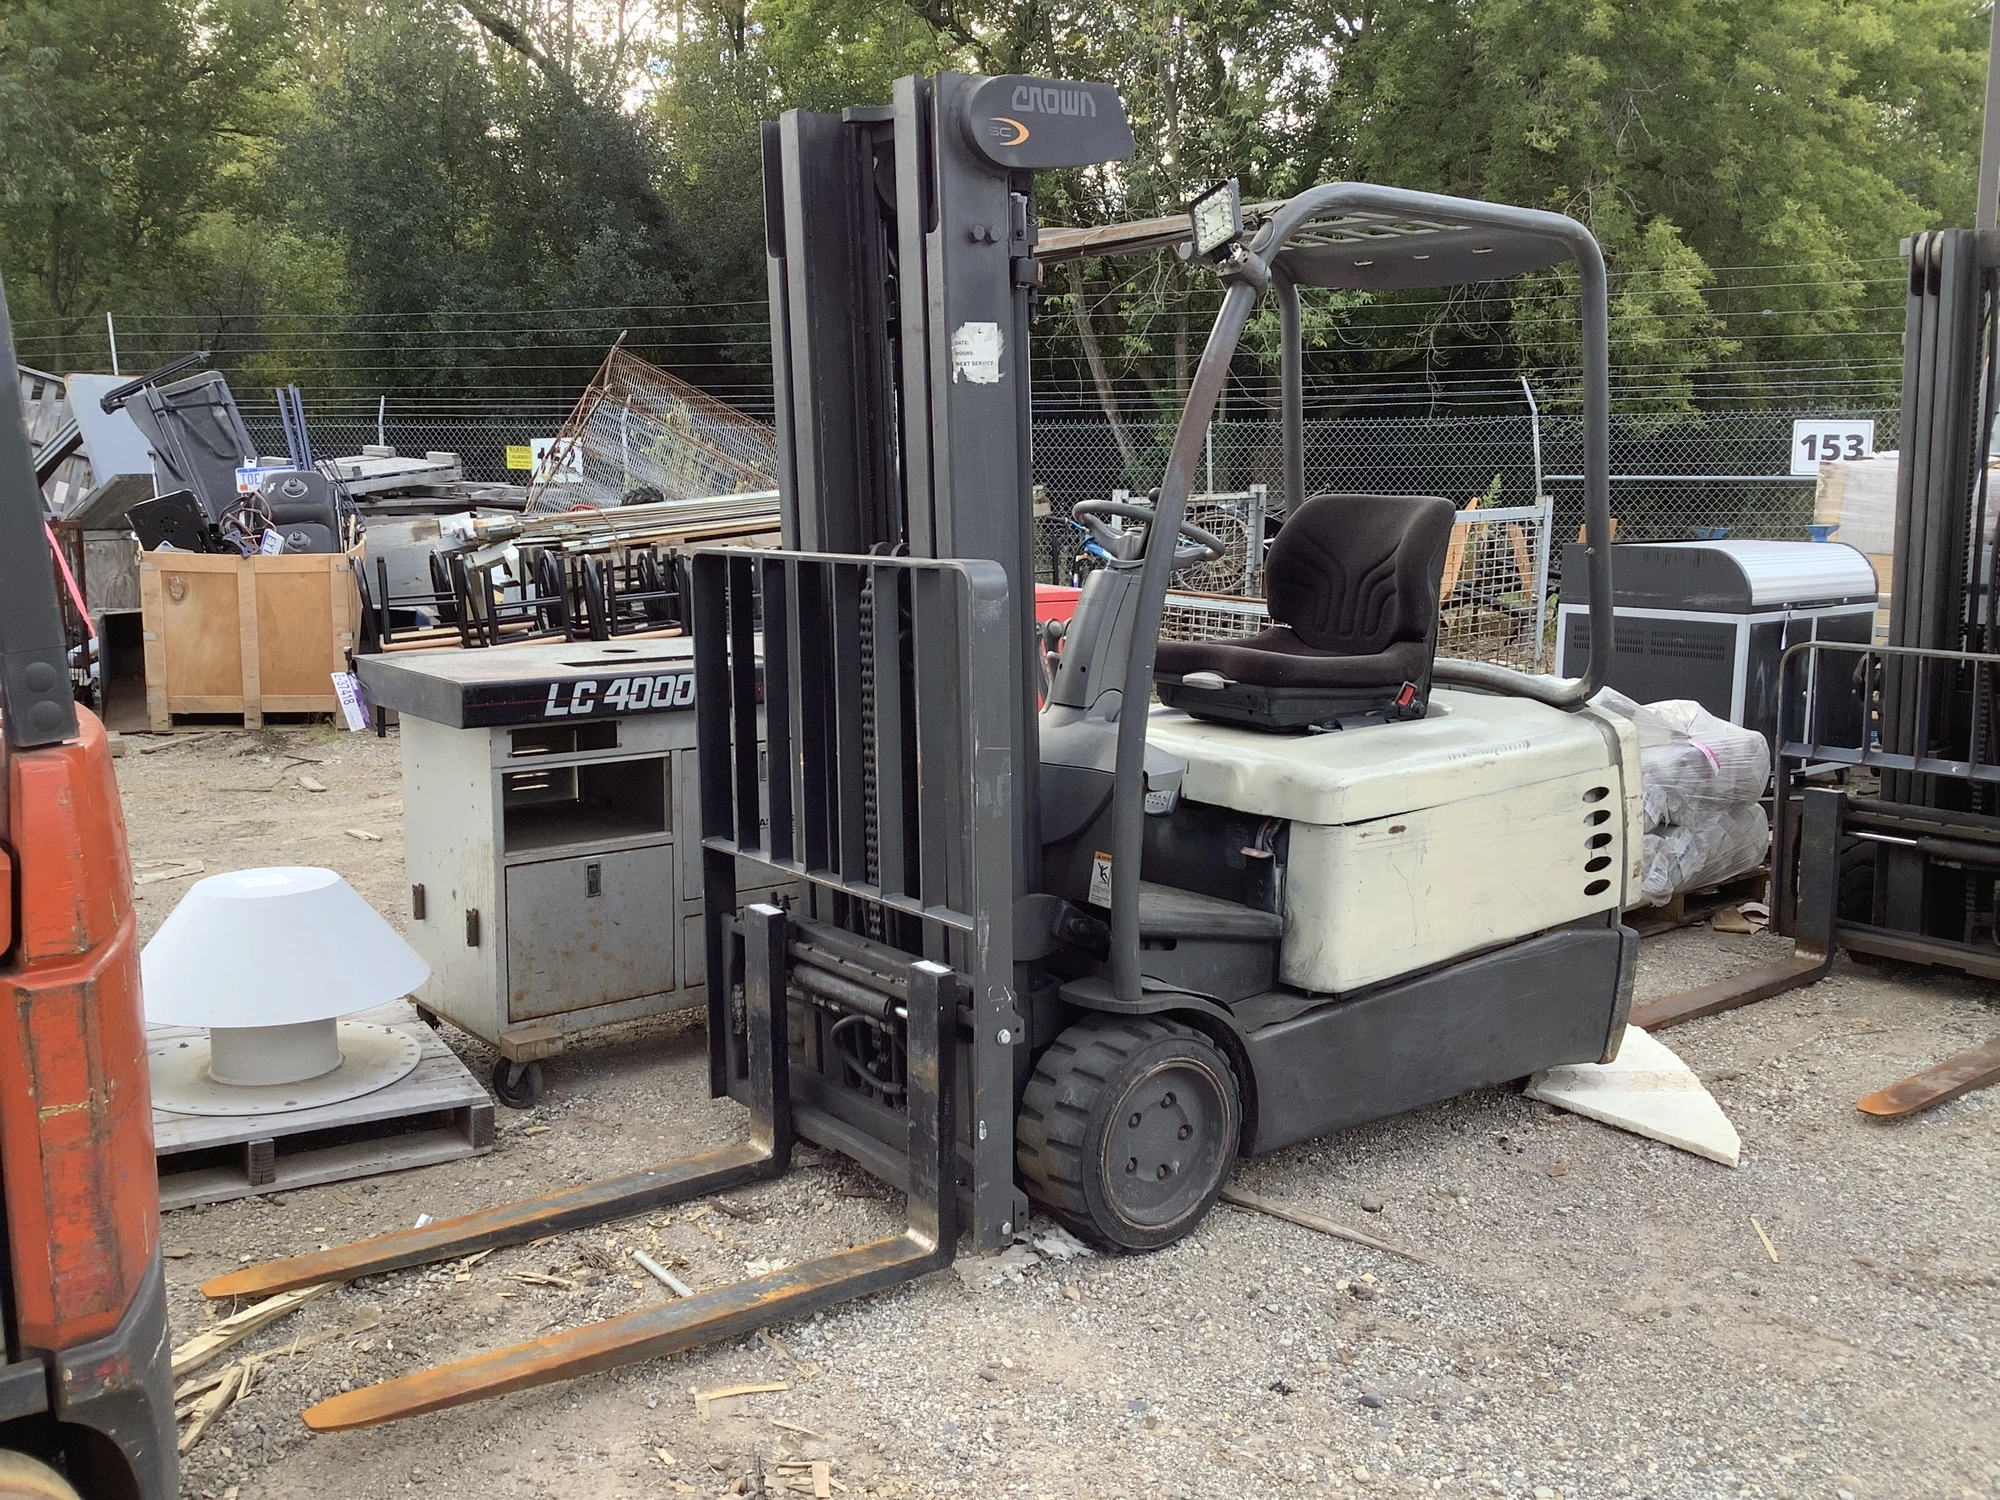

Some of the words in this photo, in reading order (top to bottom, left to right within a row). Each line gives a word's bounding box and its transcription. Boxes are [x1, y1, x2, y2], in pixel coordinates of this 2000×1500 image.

[1012, 85, 1096, 118] CROWN
[1800, 434, 1864, 461] 153
[333, 673, 355, 706] 2-37418
[544, 680, 597, 717] LC
[603, 674, 695, 711] 4000
